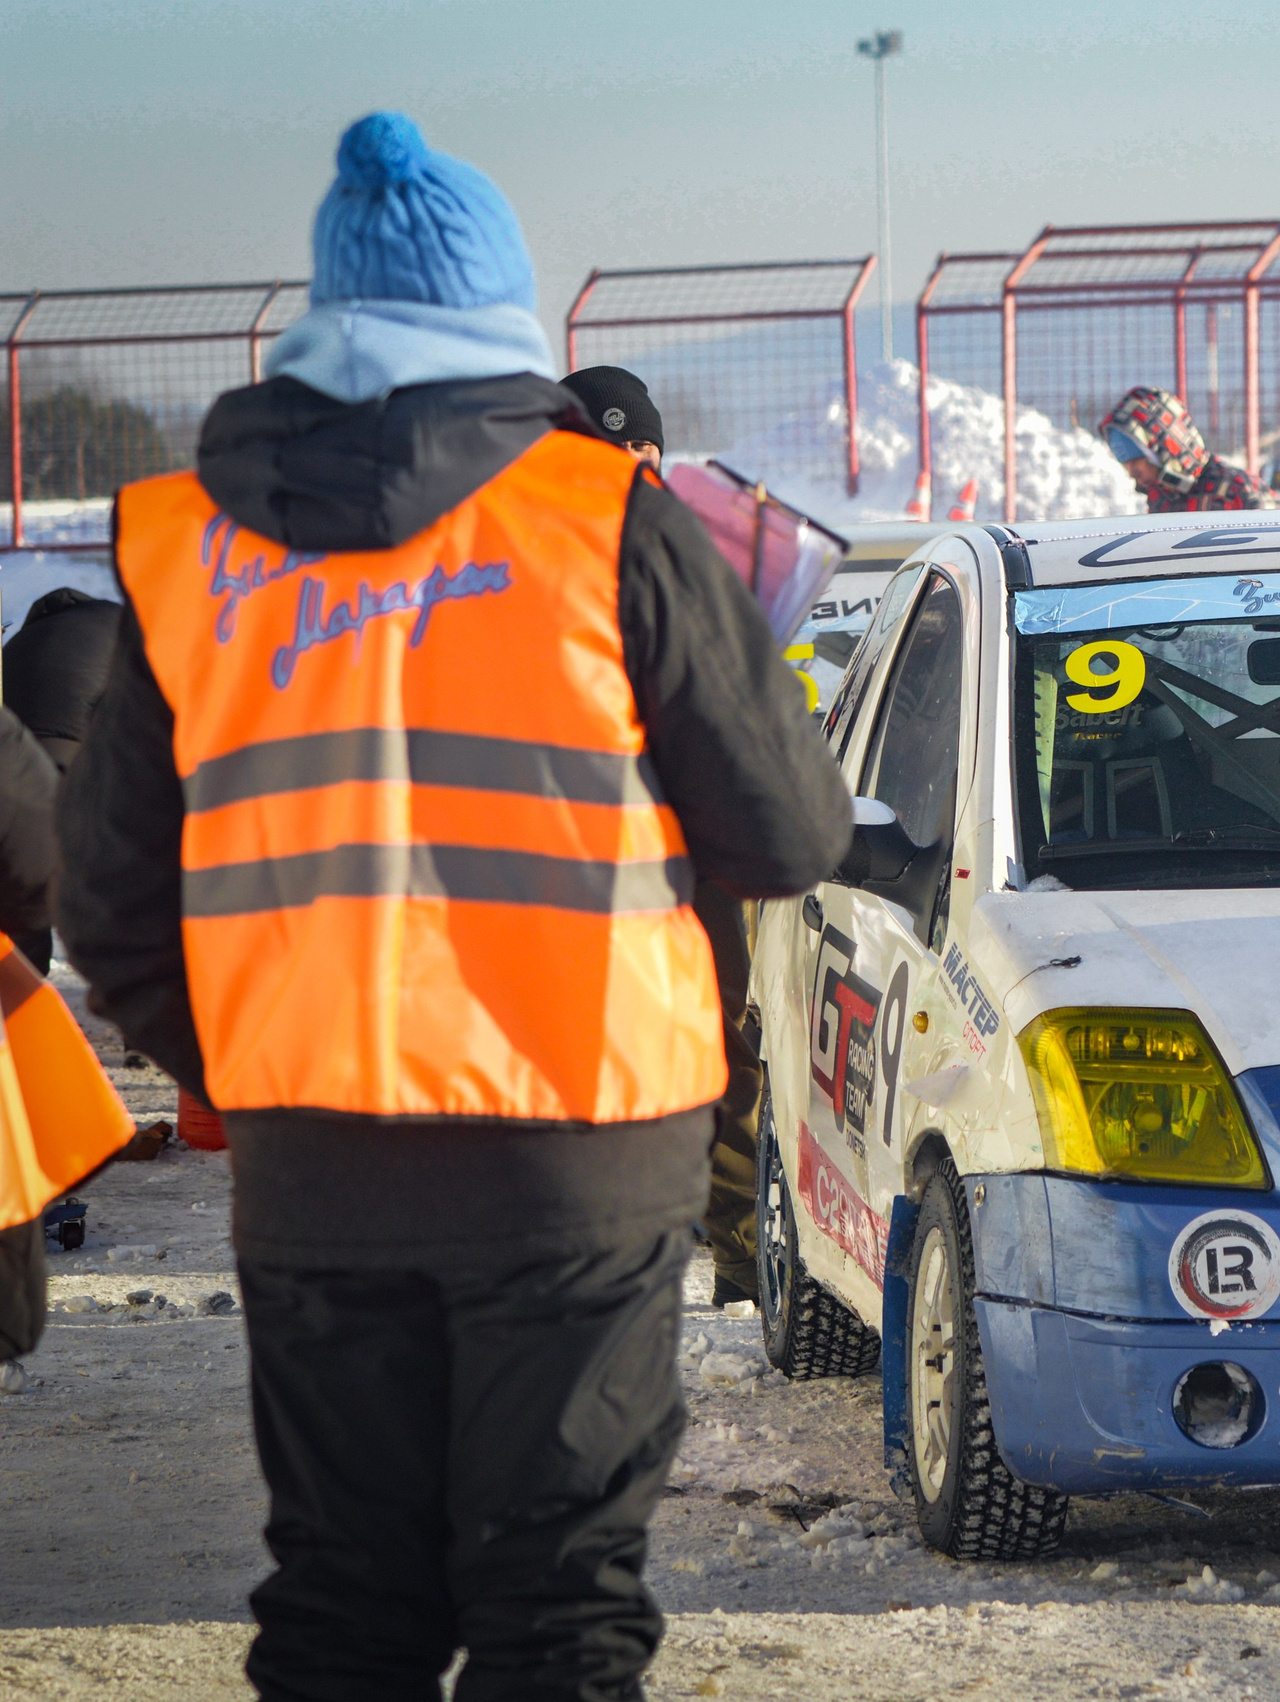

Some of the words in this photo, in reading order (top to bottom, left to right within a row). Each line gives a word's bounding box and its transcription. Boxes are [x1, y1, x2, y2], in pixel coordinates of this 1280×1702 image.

[1065, 640, 1146, 713] 9
[943, 942, 999, 1037] МАСТЕР
[847, 1038, 874, 1082] RACING
[881, 960, 909, 1148] 9
[845, 1080, 866, 1120] TEAM
